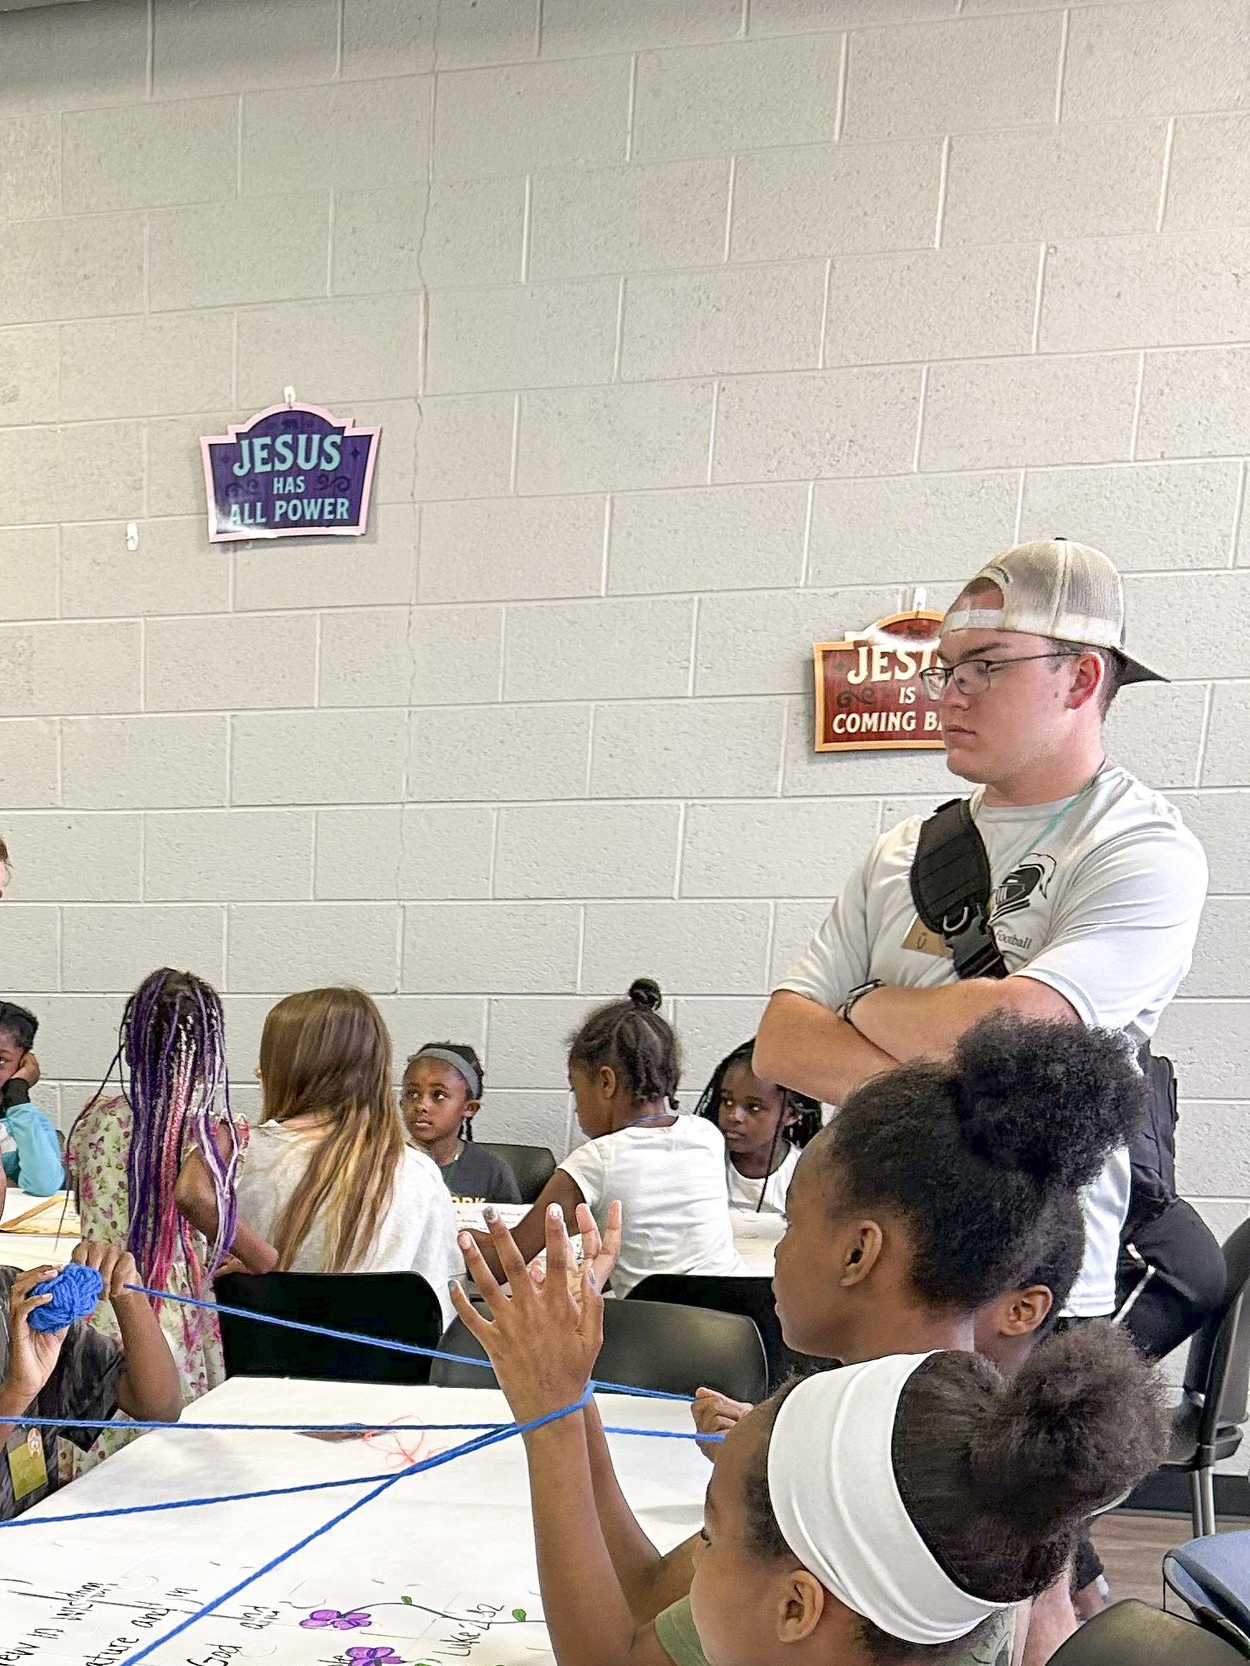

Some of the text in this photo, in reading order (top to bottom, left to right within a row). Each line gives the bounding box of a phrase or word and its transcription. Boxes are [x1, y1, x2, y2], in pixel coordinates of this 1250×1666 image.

[232, 433, 344, 477] JESUS
[272, 475, 306, 495] HAS
[230, 498, 350, 526] ALL POWER
[899, 687, 916, 705] IS
[832, 711, 943, 734] COMING B
[164, 1586, 199, 1598] in
[25, 1626, 65, 1640] in
[430, 1631, 481, 1657] Luke
